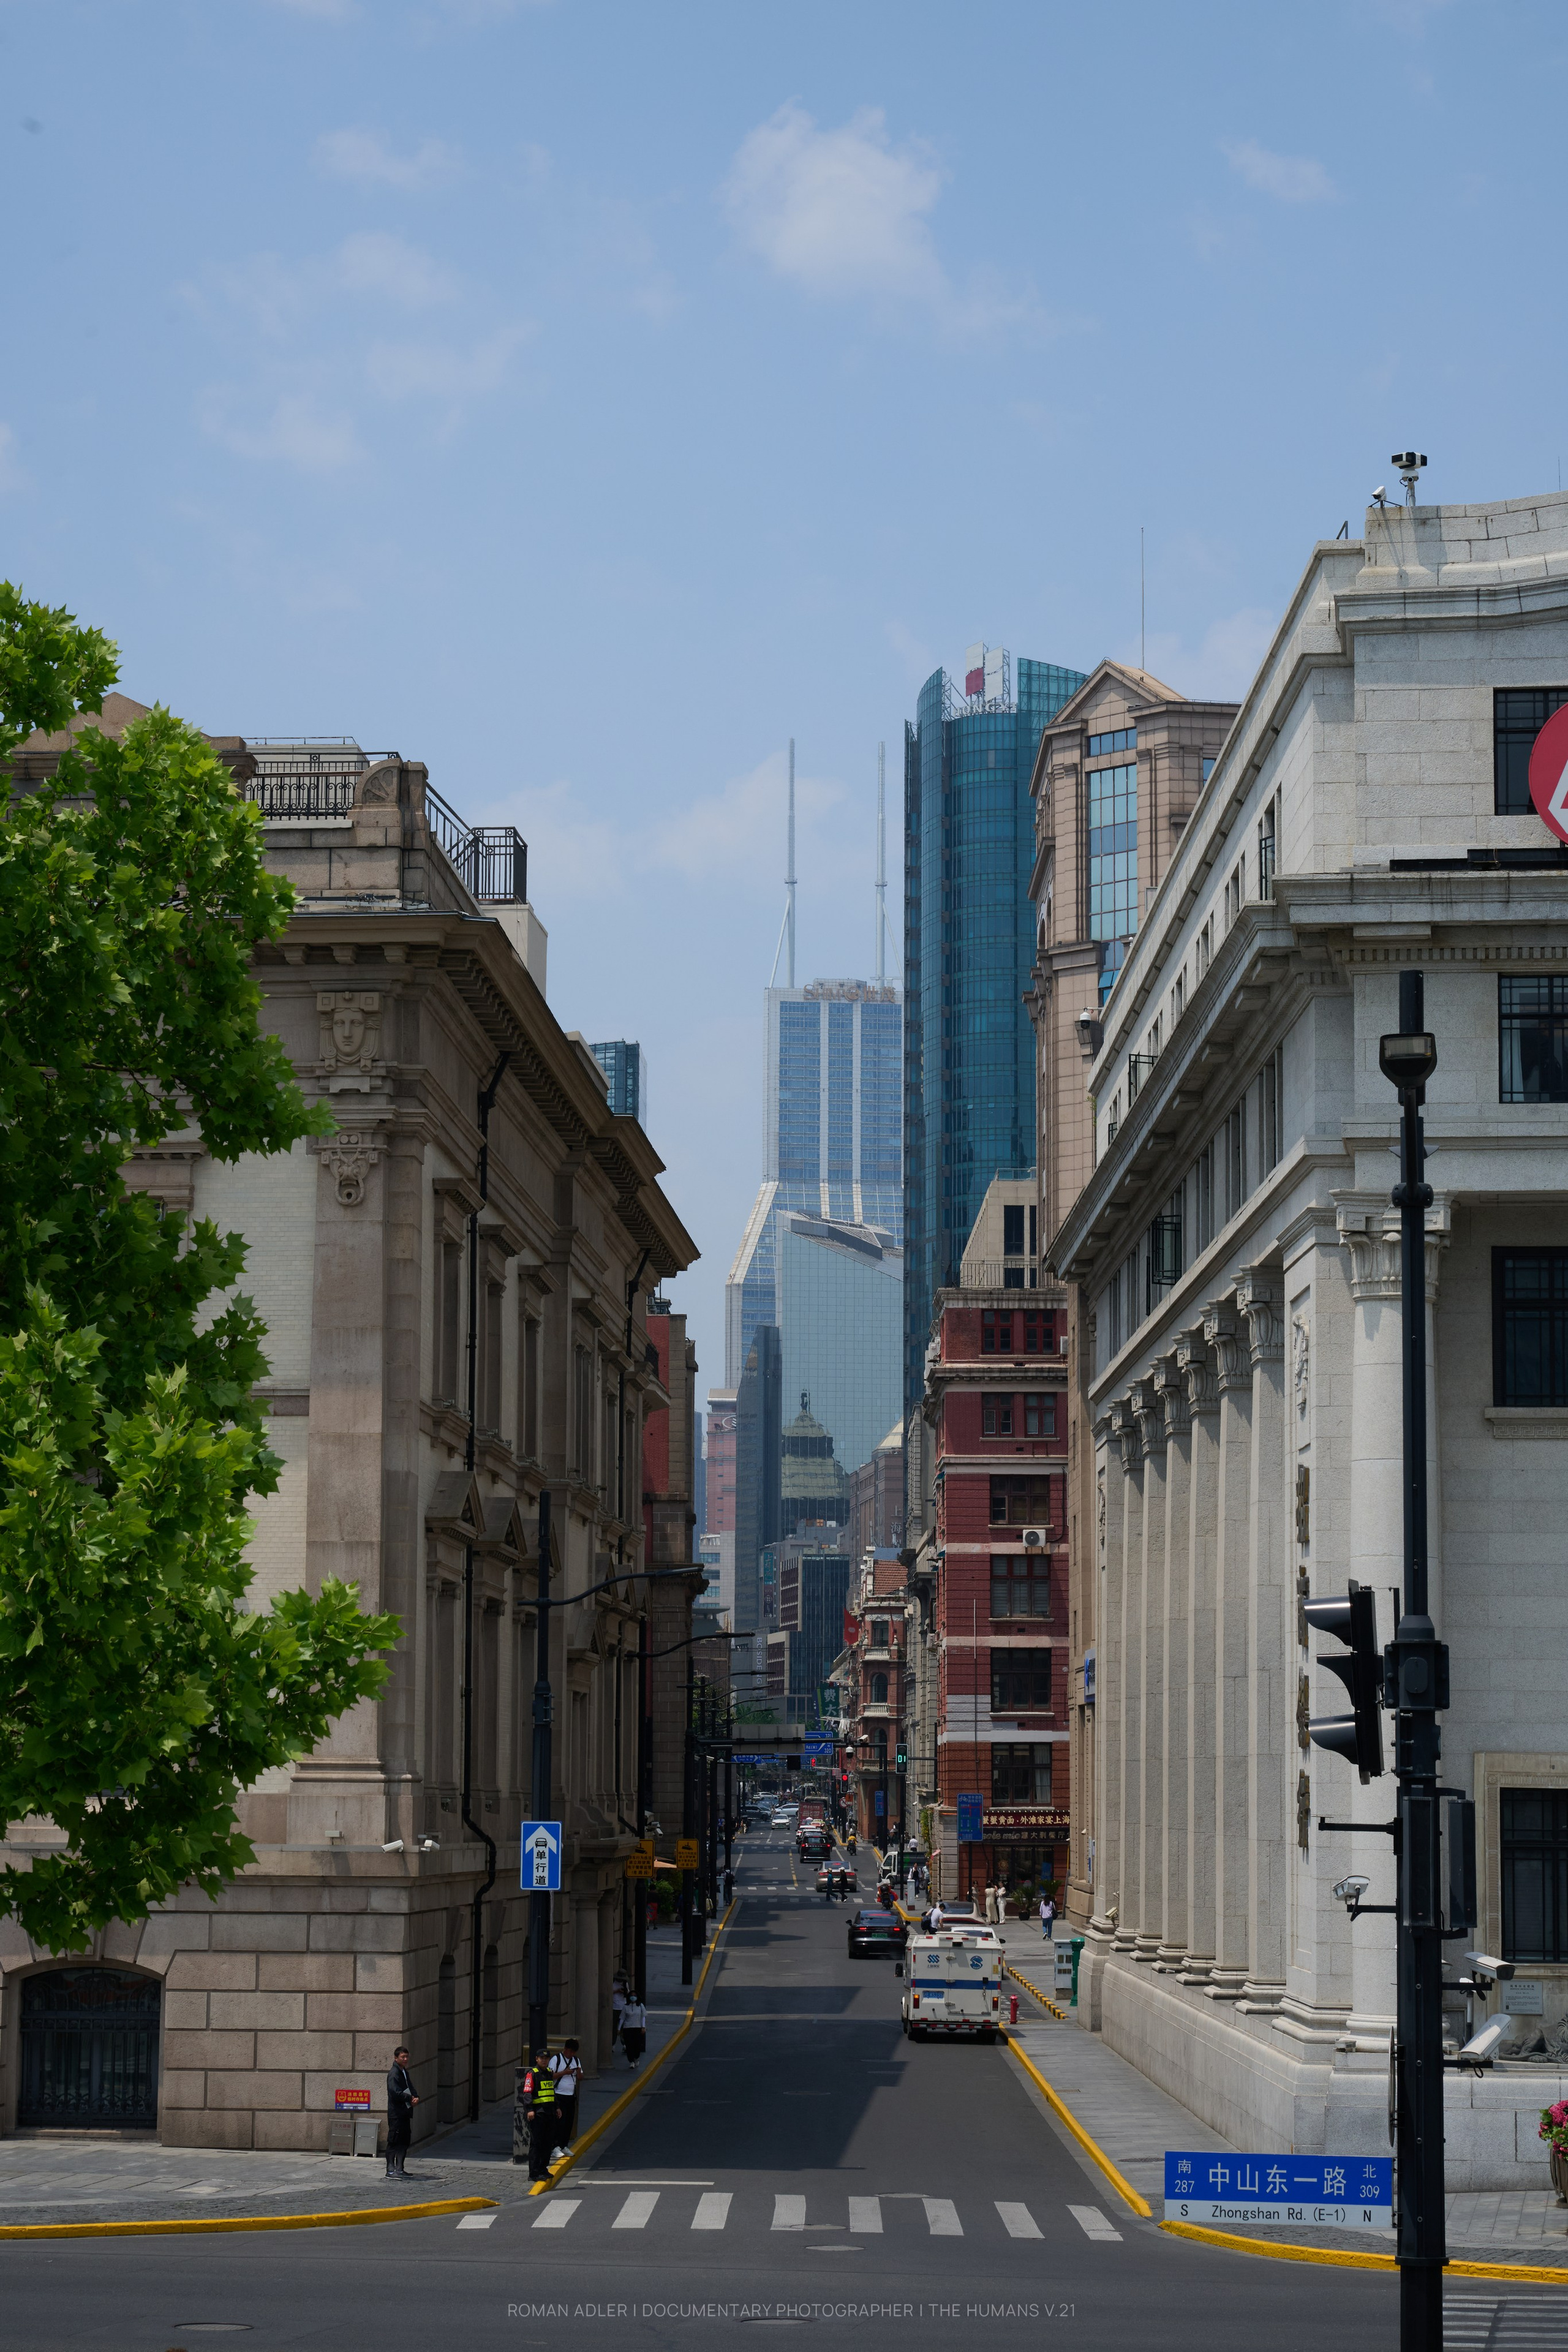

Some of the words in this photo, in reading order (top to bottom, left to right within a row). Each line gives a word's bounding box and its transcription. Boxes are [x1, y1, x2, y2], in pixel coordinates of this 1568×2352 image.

[535, 1850, 547, 1885] 单行道
[1178, 2159, 1191, 2174] 南
[1362, 2164, 1376, 2179] 北
[1175, 2180, 1194, 2193] 287
[1209, 2162, 1346, 2196] 中山东一路
[1359, 2185, 1379, 2198] 309
[1180, 2204, 1188, 2216] S
[1212, 2205, 1280, 2221] Zhongshan
[1287, 2207, 1306, 2220] Rd.
[1313, 2207, 1346, 2223] (E-1)
[1363, 2210, 1371, 2222] N
